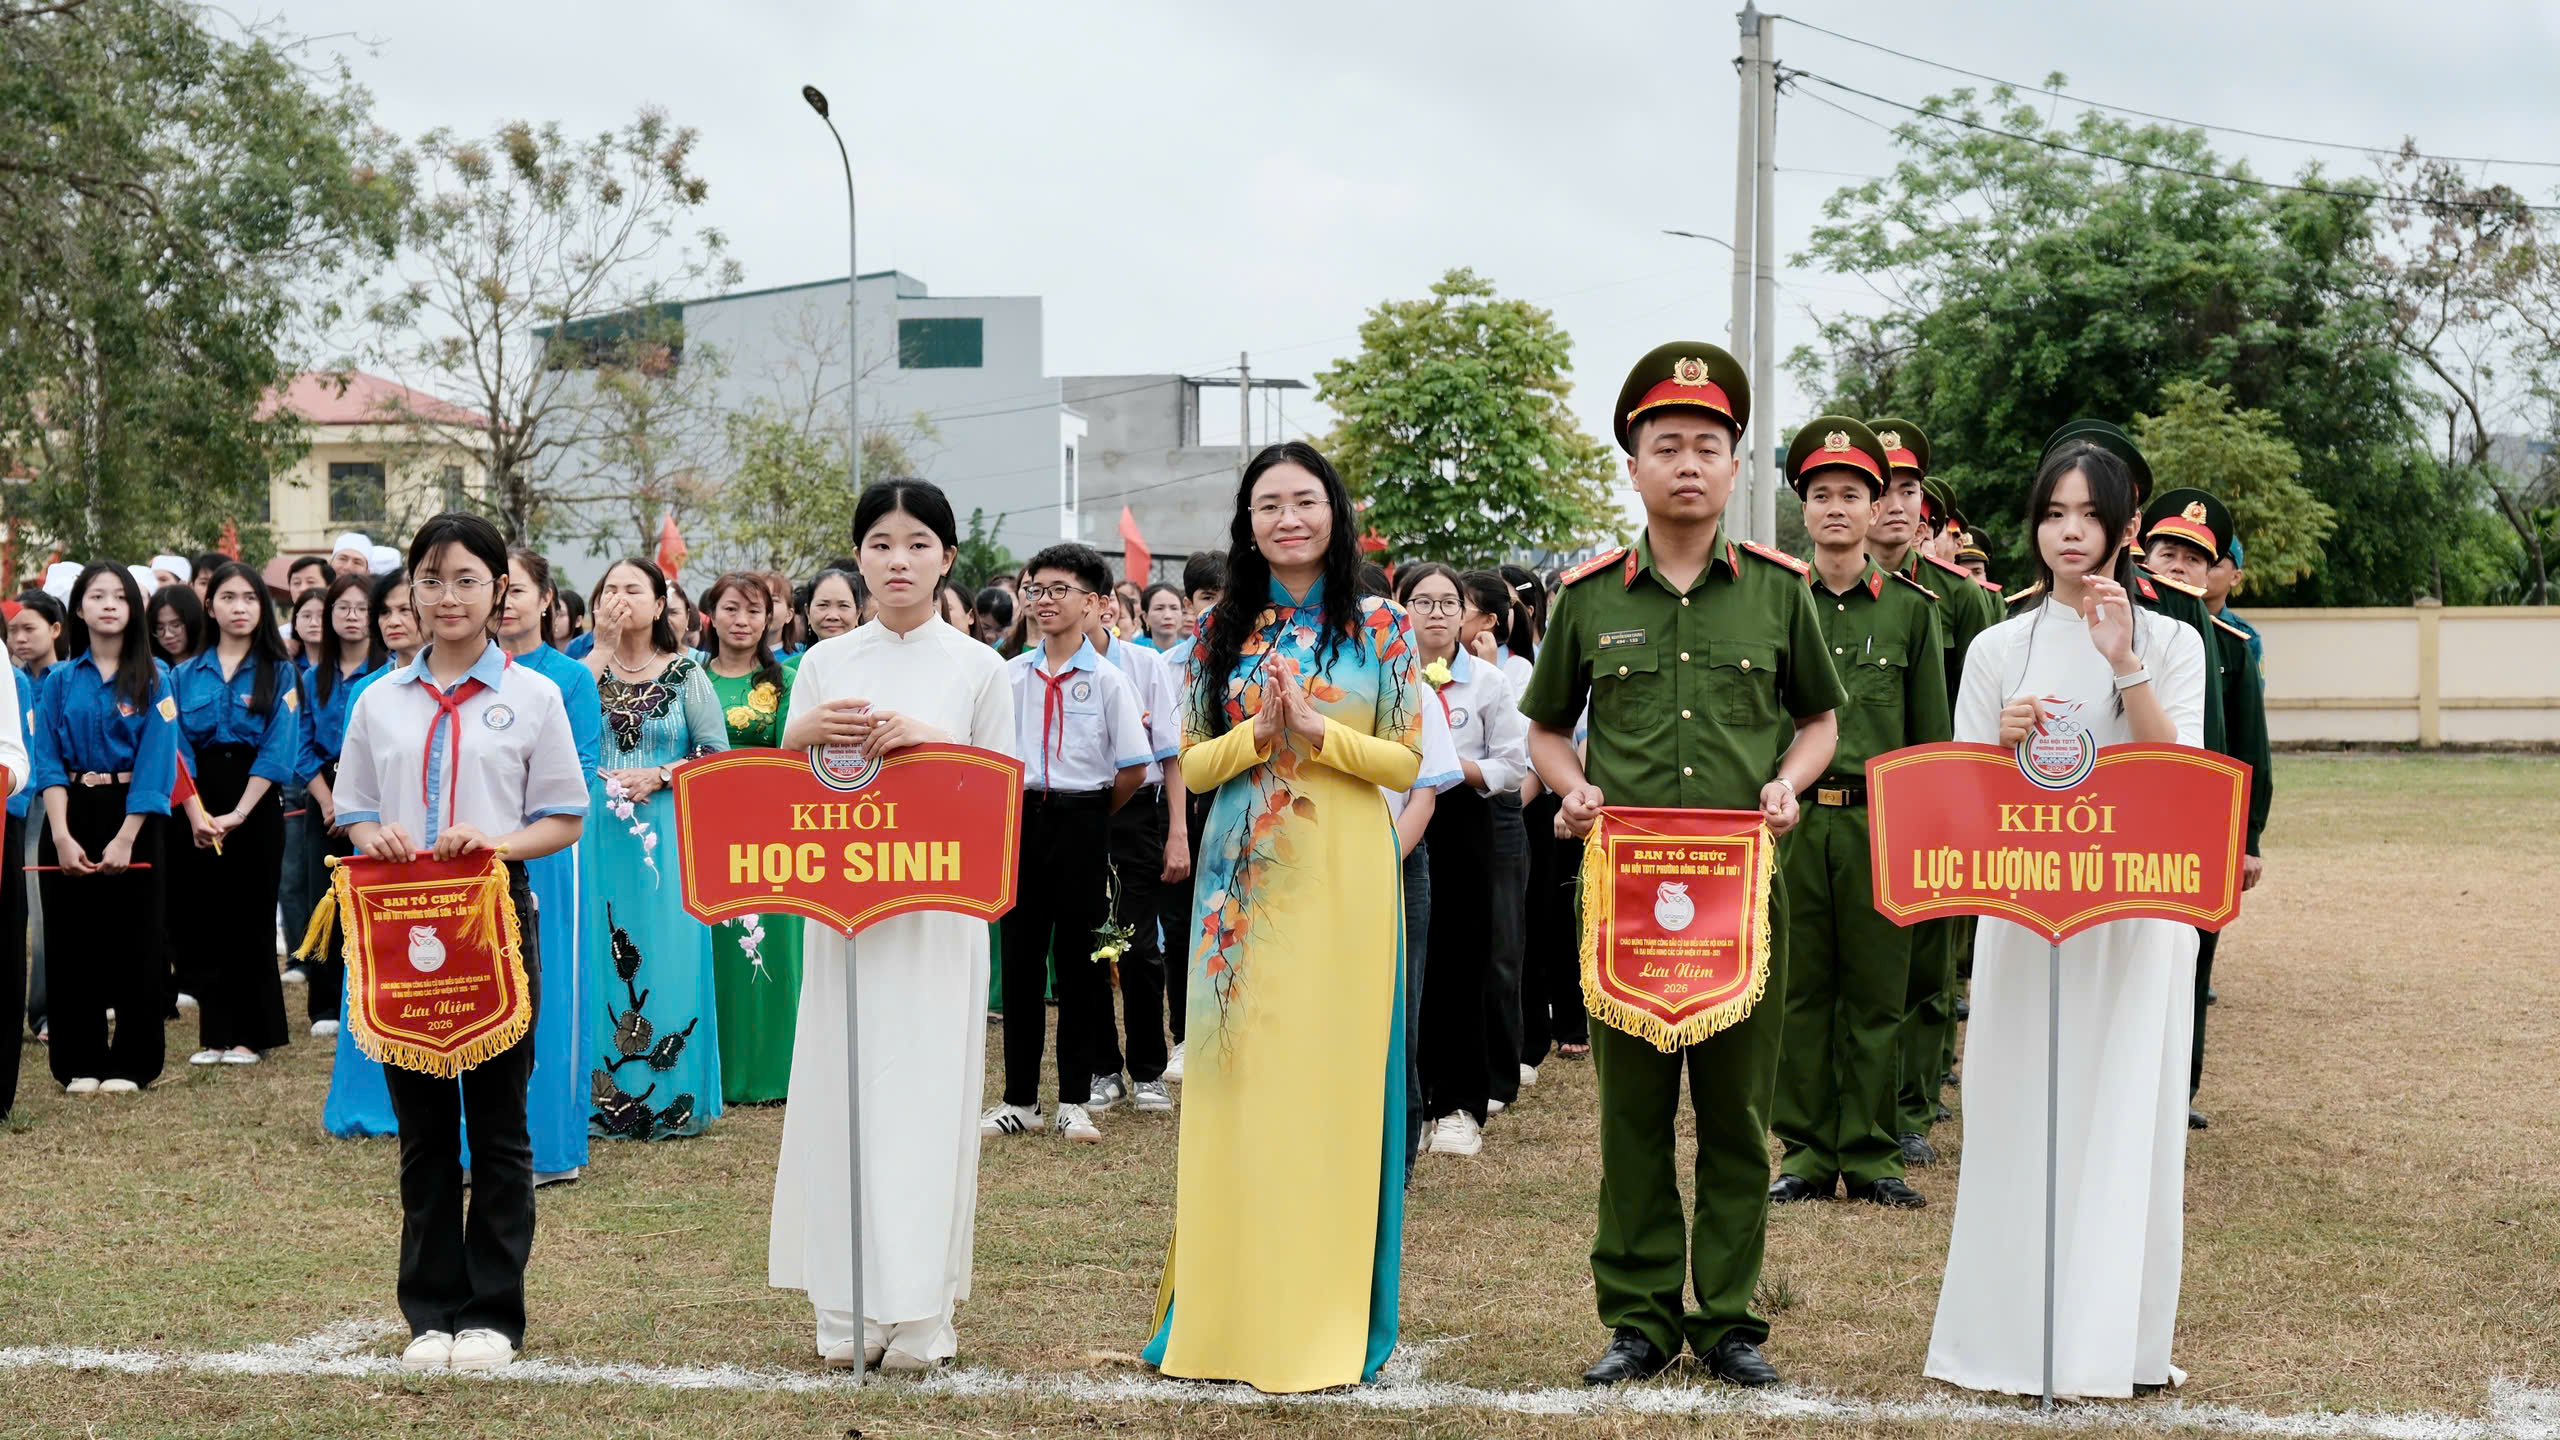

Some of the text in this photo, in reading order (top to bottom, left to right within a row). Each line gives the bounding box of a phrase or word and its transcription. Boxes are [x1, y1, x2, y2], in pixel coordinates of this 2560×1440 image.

[790, 790, 899, 831] KHỐI
[1997, 792, 2117, 834] KHỐI
[1634, 848, 1727, 861] BAN TỔ CHỨC
[729, 841, 961, 892] HỌC SINH
[1620, 864, 1630, 875] ĐẠI
[1632, 862, 1642, 875] HỘI
[1642, 864, 1656, 874] TDTT
[1656, 863, 1680, 874] PHƯỜNG
[1680, 864, 1696, 875] ĐÔNG
[1697, 865, 1710, 875] SƠN
[1714, 864, 1724, 876] LẦN
[1726, 864, 1738, 876] THỨ
[1913, 844, 2201, 899] LỰC LƯỢNG VŨ TRANG
[383, 892, 468, 907] BAN TỔ CHỨC
[456, 904, 468, 916] LẦN
[1639, 962, 1714, 981] Lưu Niệm
[1663, 984, 1689, 993] 2026
[400, 1000, 476, 1018] Lưu Niệm
[427, 1020, 454, 1031] 2026
